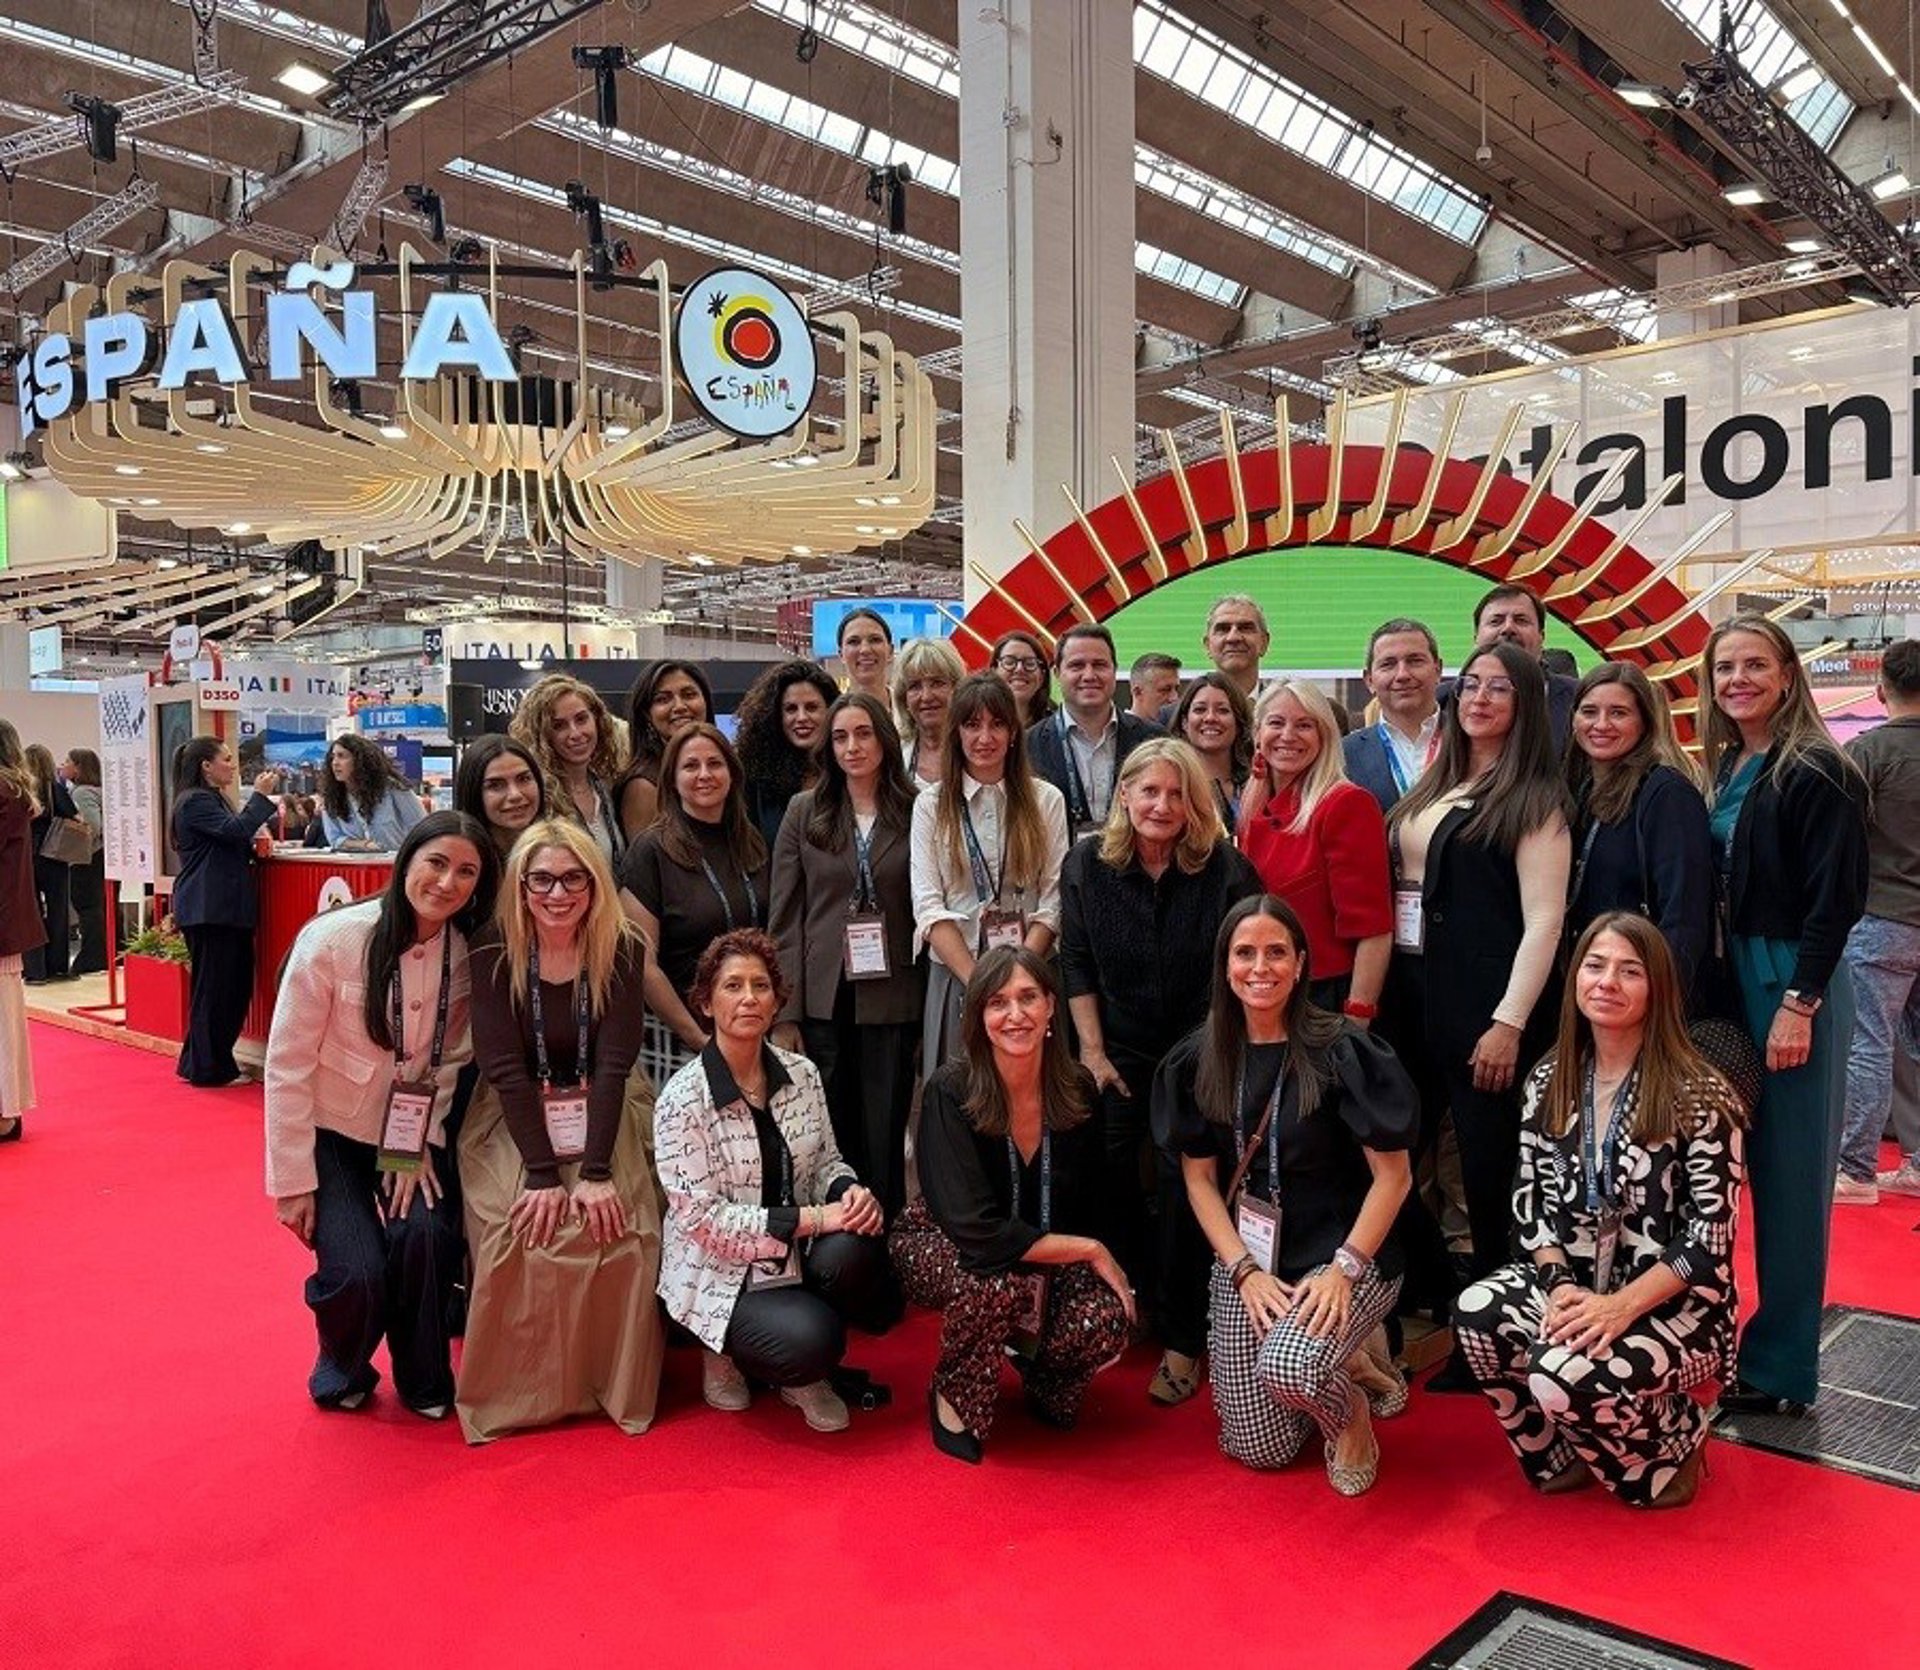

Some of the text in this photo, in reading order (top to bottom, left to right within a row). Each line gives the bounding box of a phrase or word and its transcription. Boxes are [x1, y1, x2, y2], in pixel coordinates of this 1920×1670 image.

[15, 261, 519, 441] ESPAÑA
[1397, 355, 1920, 516] talon
[203, 690, 240, 701] D350
